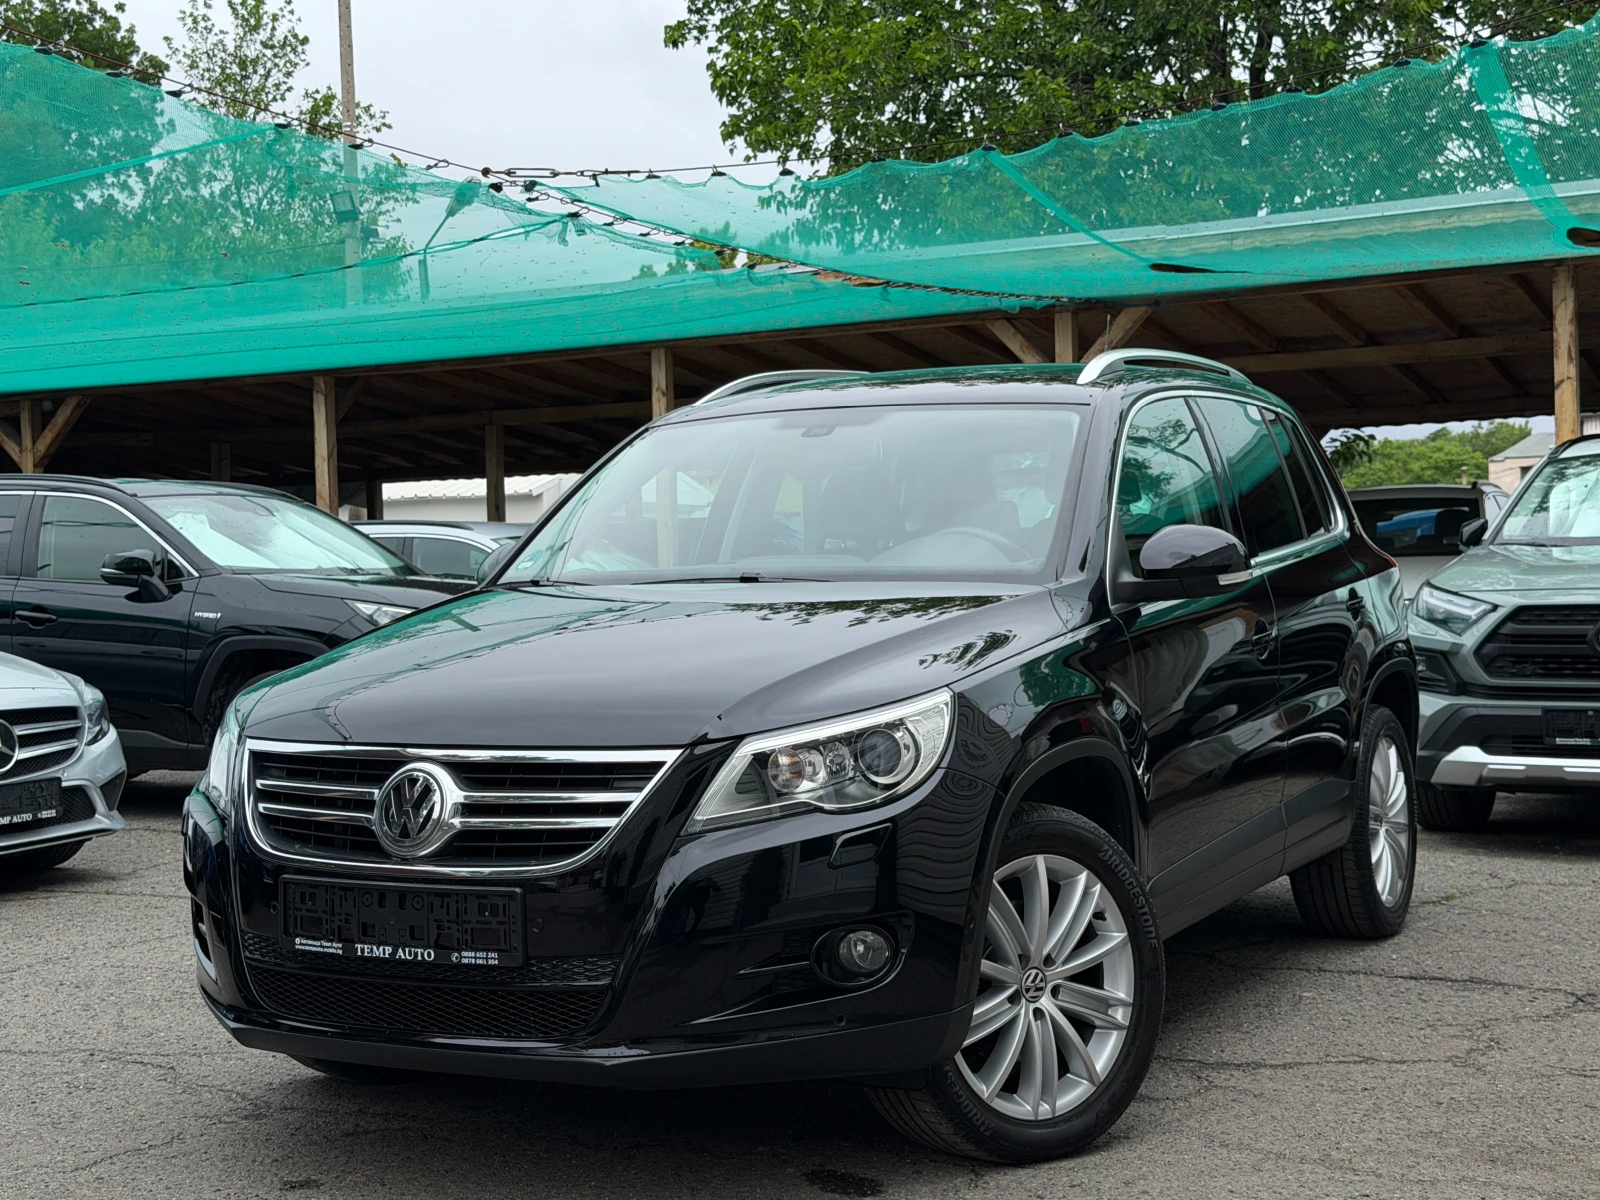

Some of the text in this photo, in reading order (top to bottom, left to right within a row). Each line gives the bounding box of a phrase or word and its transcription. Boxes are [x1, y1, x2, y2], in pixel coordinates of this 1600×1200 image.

[194, 611, 217, 619] HYBRID
[12, 813, 32, 823] AUTO
[1098, 844, 1158, 949] BRIDGESTONE
[355, 944, 434, 961] TEMP AUTO
